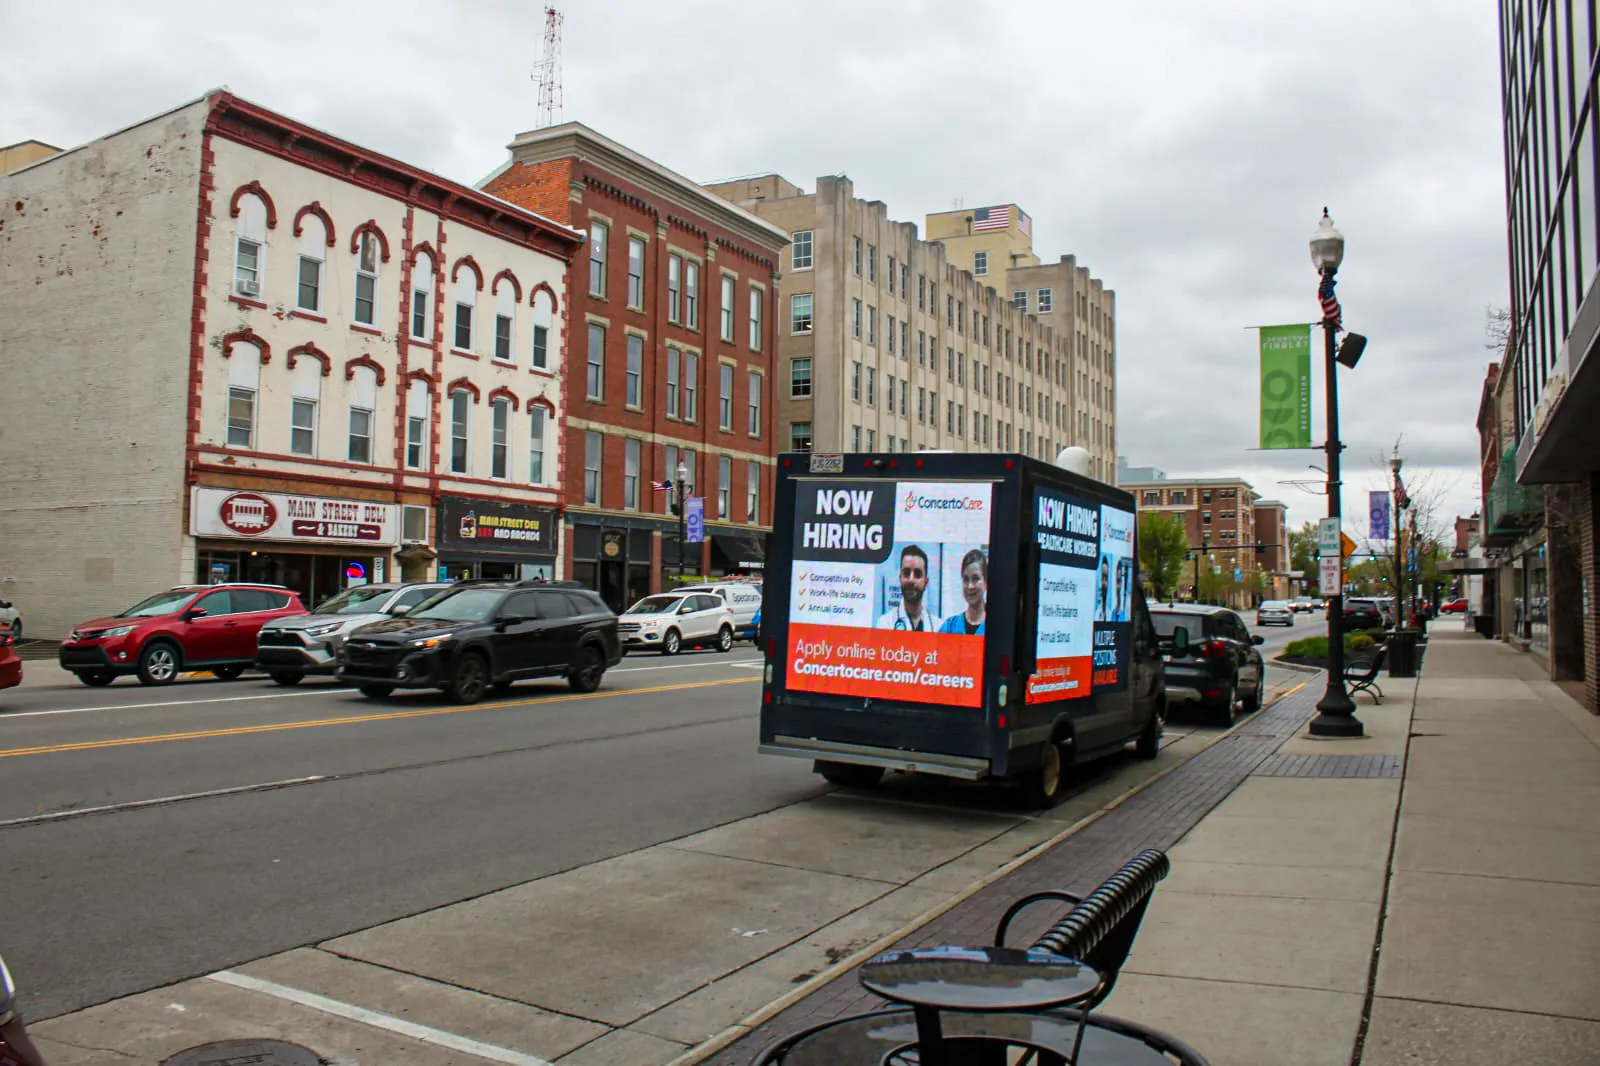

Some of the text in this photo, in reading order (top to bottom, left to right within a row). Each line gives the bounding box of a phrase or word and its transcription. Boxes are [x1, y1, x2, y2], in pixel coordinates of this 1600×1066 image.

[816, 489, 874, 516] NOW
[918, 496, 984, 510] ConcertoCare
[287, 499, 386, 524] MAIN STREET DELI
[1038, 496, 1098, 538] NOW HIRING
[479, 515, 540, 530] MAIN STREET DELI
[327, 523, 359, 538] BAKERY
[494, 528, 510, 539] AND
[510, 529, 541, 541] ARCADE
[802, 522, 883, 551] HIRING
[809, 573, 864, 585] Competitive Pay
[732, 592, 758, 602] Spectrum
[808, 604, 854, 615] Annual Bonus
[795, 639, 939, 666] Apply online today at
[793, 658, 974, 689] Concertocare.com/careers
